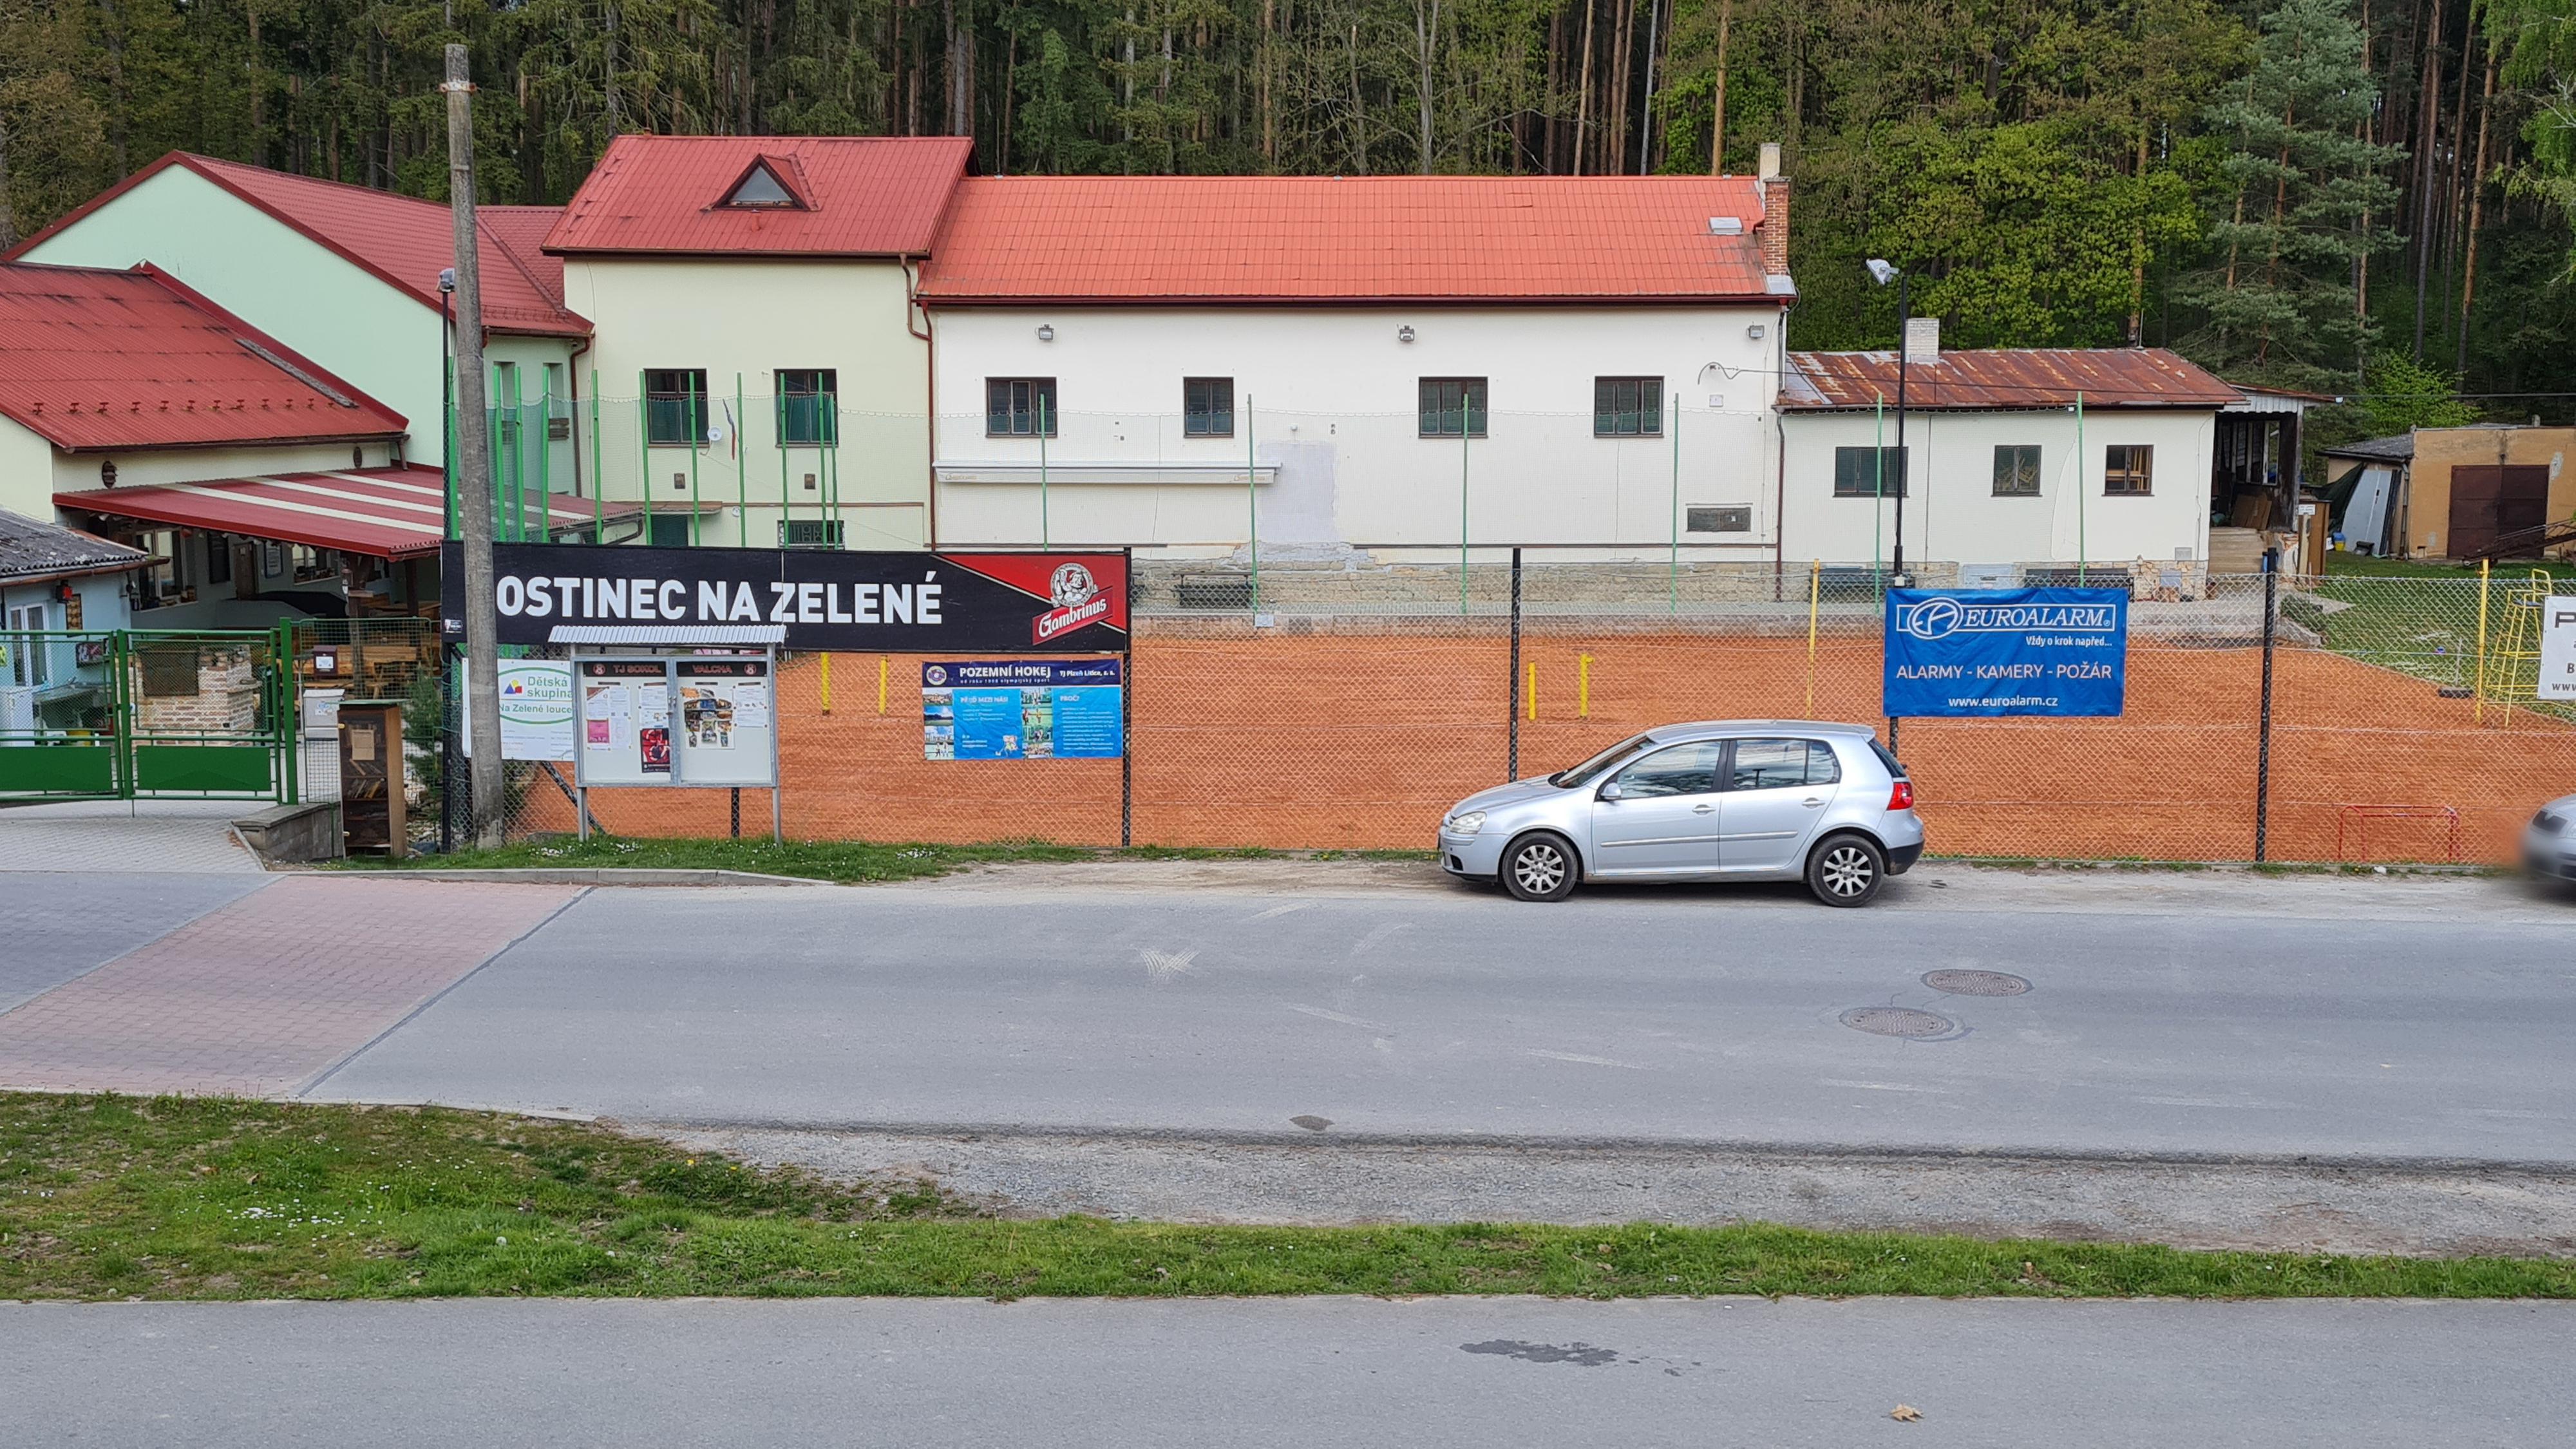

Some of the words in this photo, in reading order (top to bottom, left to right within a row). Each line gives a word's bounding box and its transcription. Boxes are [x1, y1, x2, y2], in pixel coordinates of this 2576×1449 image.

[496, 576, 686, 620] OSTINEC
[697, 580, 761, 622] NA
[770, 571, 942, 625] ZELENÉ
[1038, 598, 1107, 638] Gambrinus
[2026, 635, 2046, 647] Vždy
[2054, 635, 2073, 646] krok
[613, 665, 625, 673] TJ
[627, 665, 661, 673] SOKOL
[960, 664, 1012, 677] POZEMNÍ
[1015, 666, 1052, 678] HOKEJ
[1896, 665, 1964, 679] ALARMY
[1976, 664, 2044, 678] KAMERY
[2056, 661, 2112, 679] POŽÁR
[527, 676, 568, 687] Dětská
[1948, 695, 2058, 707] www.euroalarm.cz
[513, 703, 544, 713] Zelené
[546, 705, 573, 714] louce
